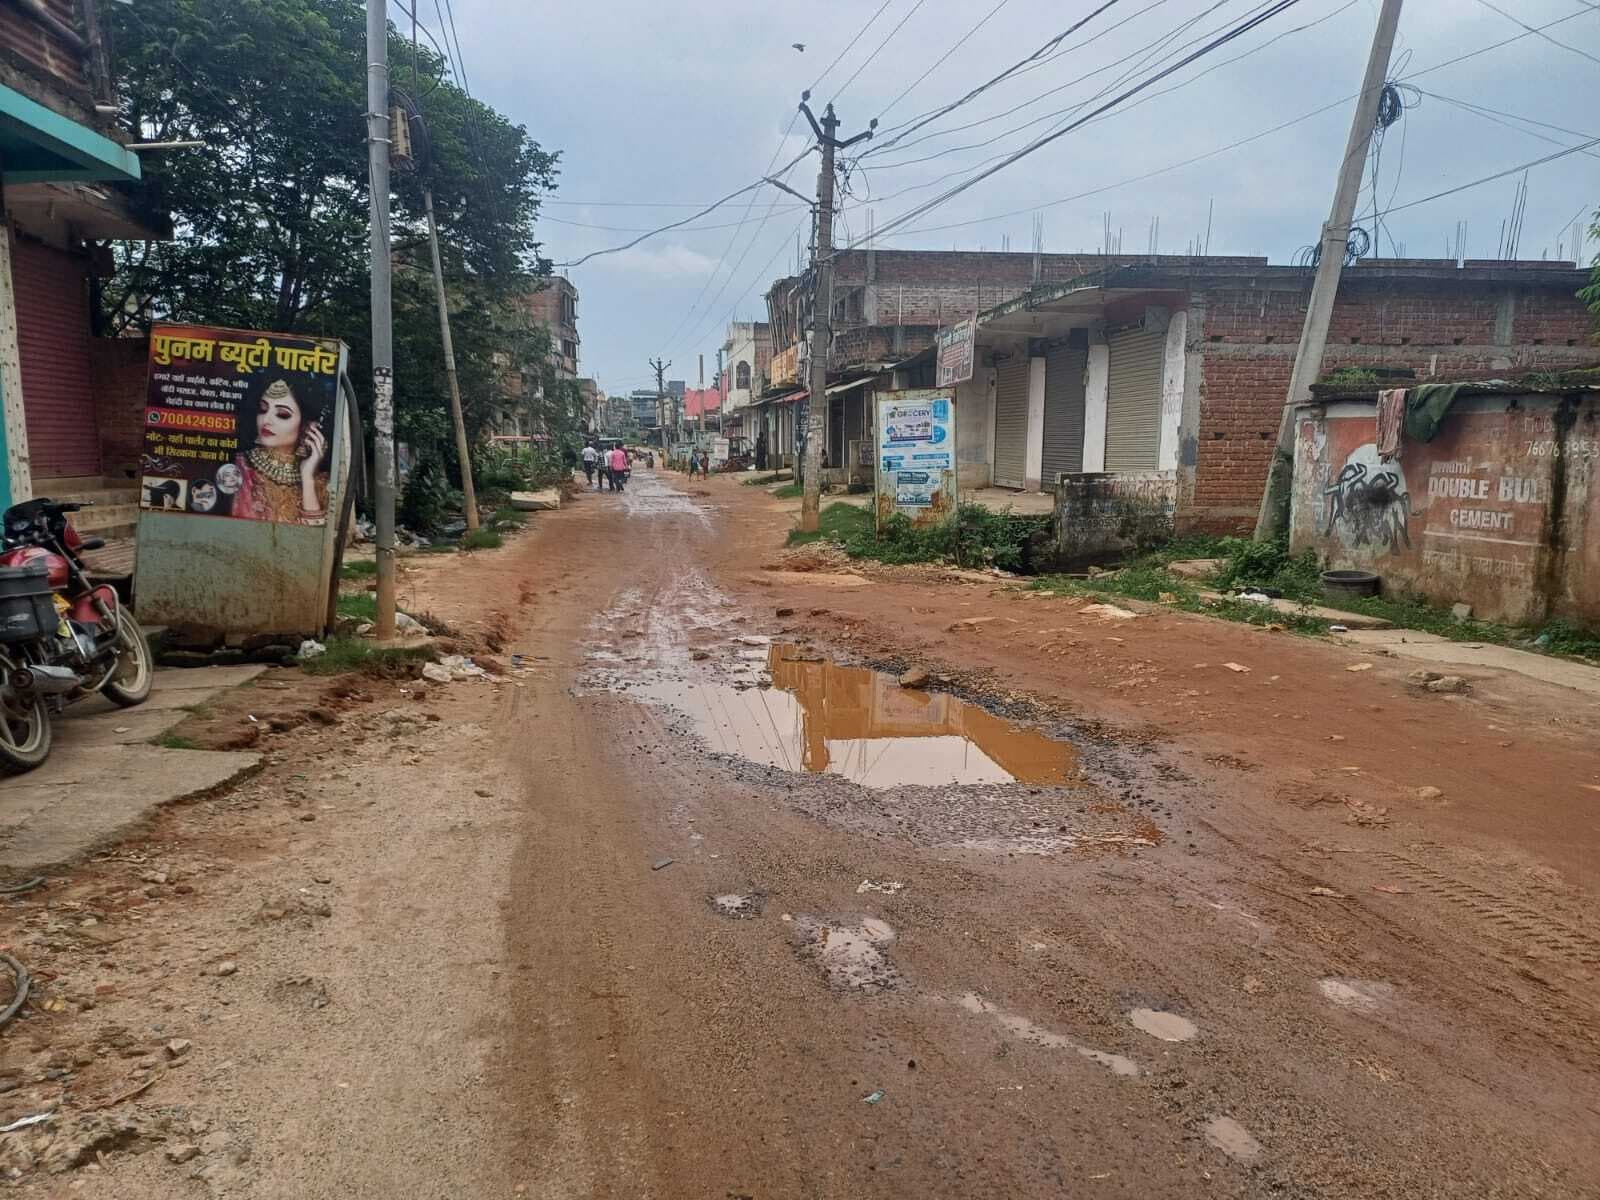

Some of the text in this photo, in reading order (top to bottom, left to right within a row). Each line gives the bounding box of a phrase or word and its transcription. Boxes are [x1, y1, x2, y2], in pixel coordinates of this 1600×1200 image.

[154, 335, 337, 375] पुनम ब्यूटी पार्लर
[161, 412, 236, 430] 7004249631
[1427, 477, 1490, 500] DOUBLE
[1450, 510, 1514, 530] CEMENT
